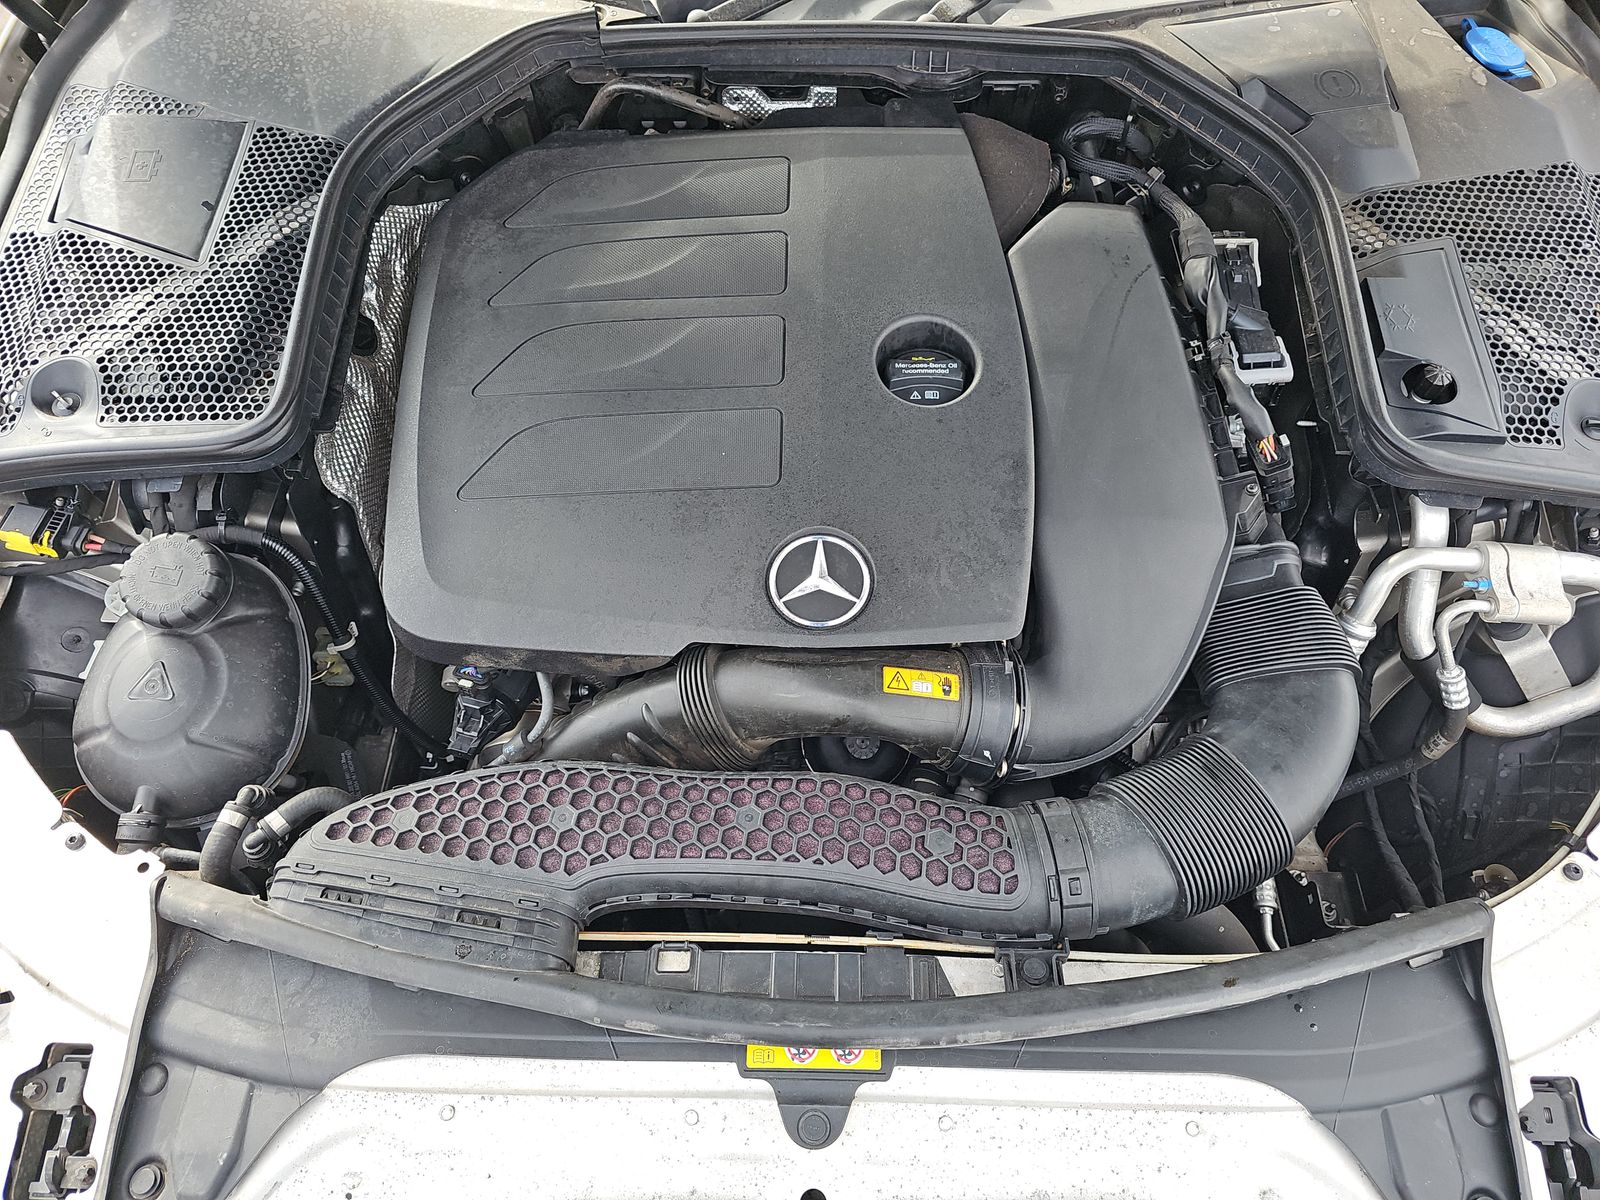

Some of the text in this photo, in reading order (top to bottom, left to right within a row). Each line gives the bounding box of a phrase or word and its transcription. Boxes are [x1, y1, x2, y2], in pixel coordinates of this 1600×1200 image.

[134, 555, 145, 566] DO
[162, 541, 182, 549] OPEN
[183, 544, 202, 562] WHEN
[195, 561, 205, 576] HOT
